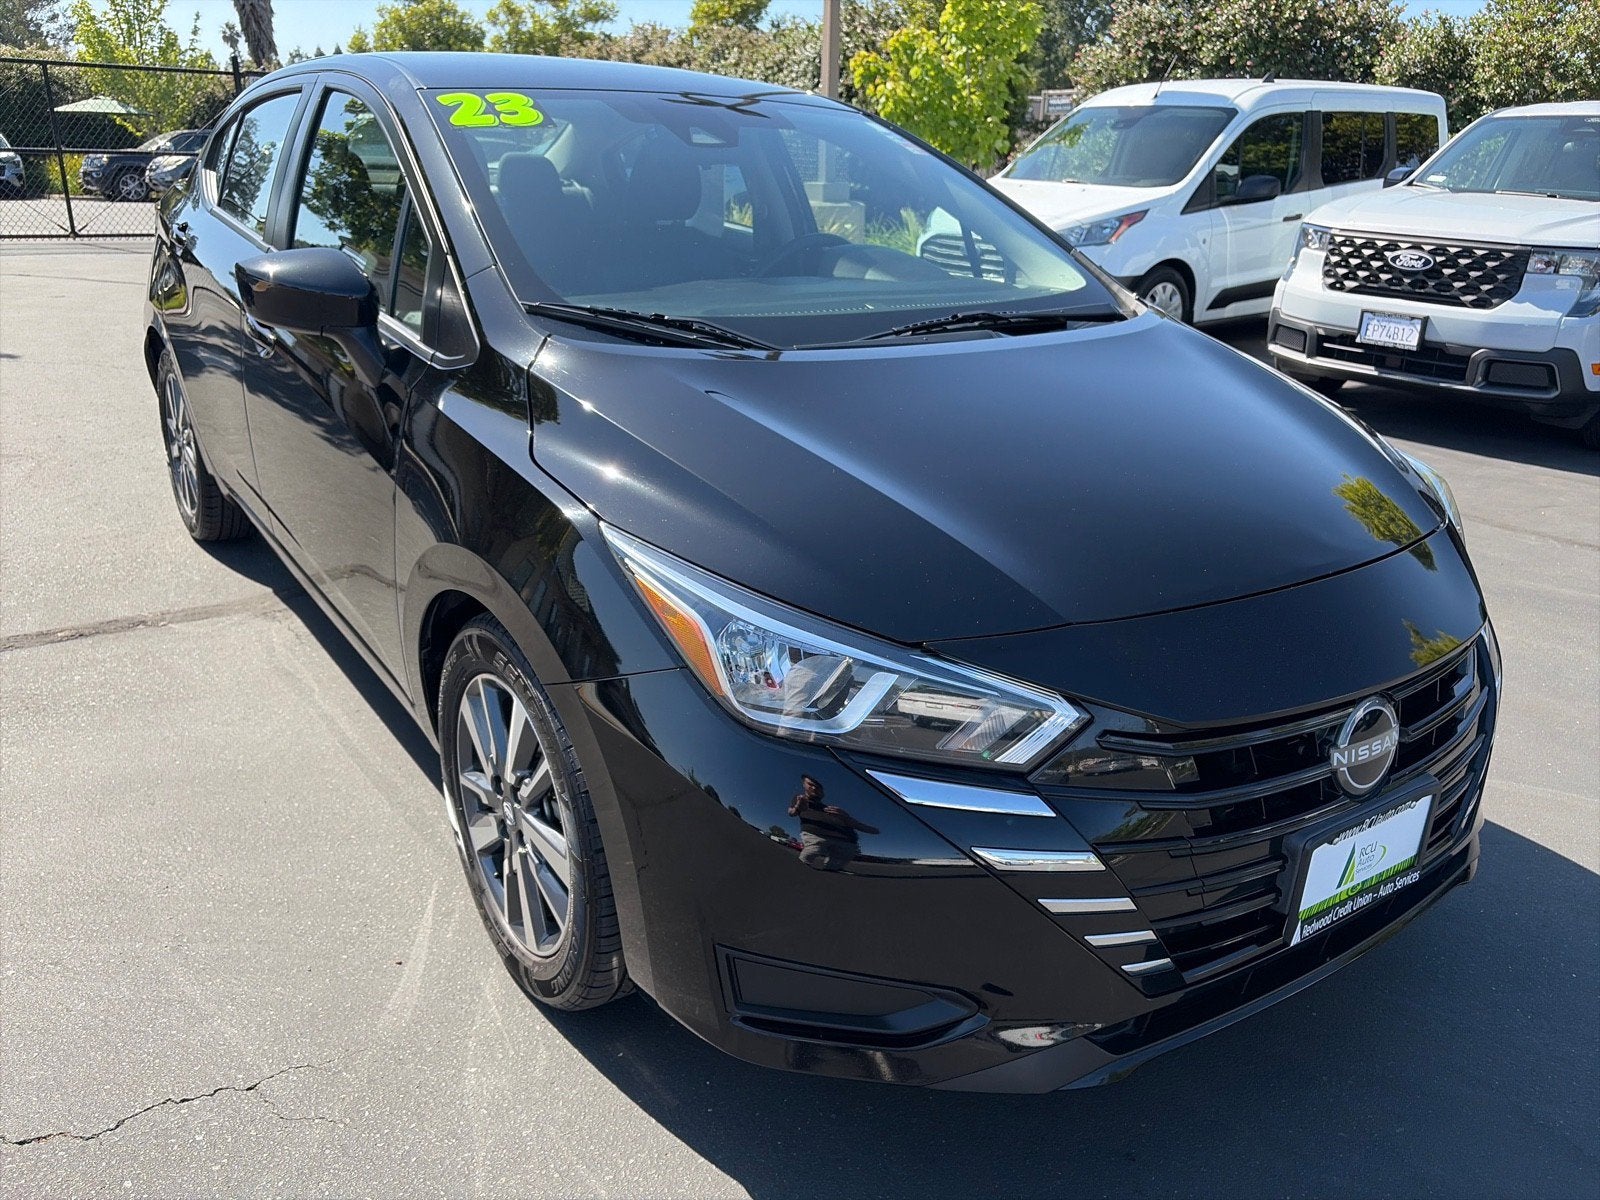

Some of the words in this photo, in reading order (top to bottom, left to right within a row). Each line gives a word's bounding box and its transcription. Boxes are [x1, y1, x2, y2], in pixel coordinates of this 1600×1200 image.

[436, 92, 544, 128] 23
[1396, 255, 1425, 268] Ford
[1333, 731, 1399, 766] NISSAN
[1359, 841, 1378, 858] RCU
[1302, 909, 1334, 938] Redwood
[1333, 900, 1354, 920] Credit
[1353, 892, 1373, 911] Union
[1378, 882, 1395, 899] Auto
[1394, 870, 1420, 891] Services
